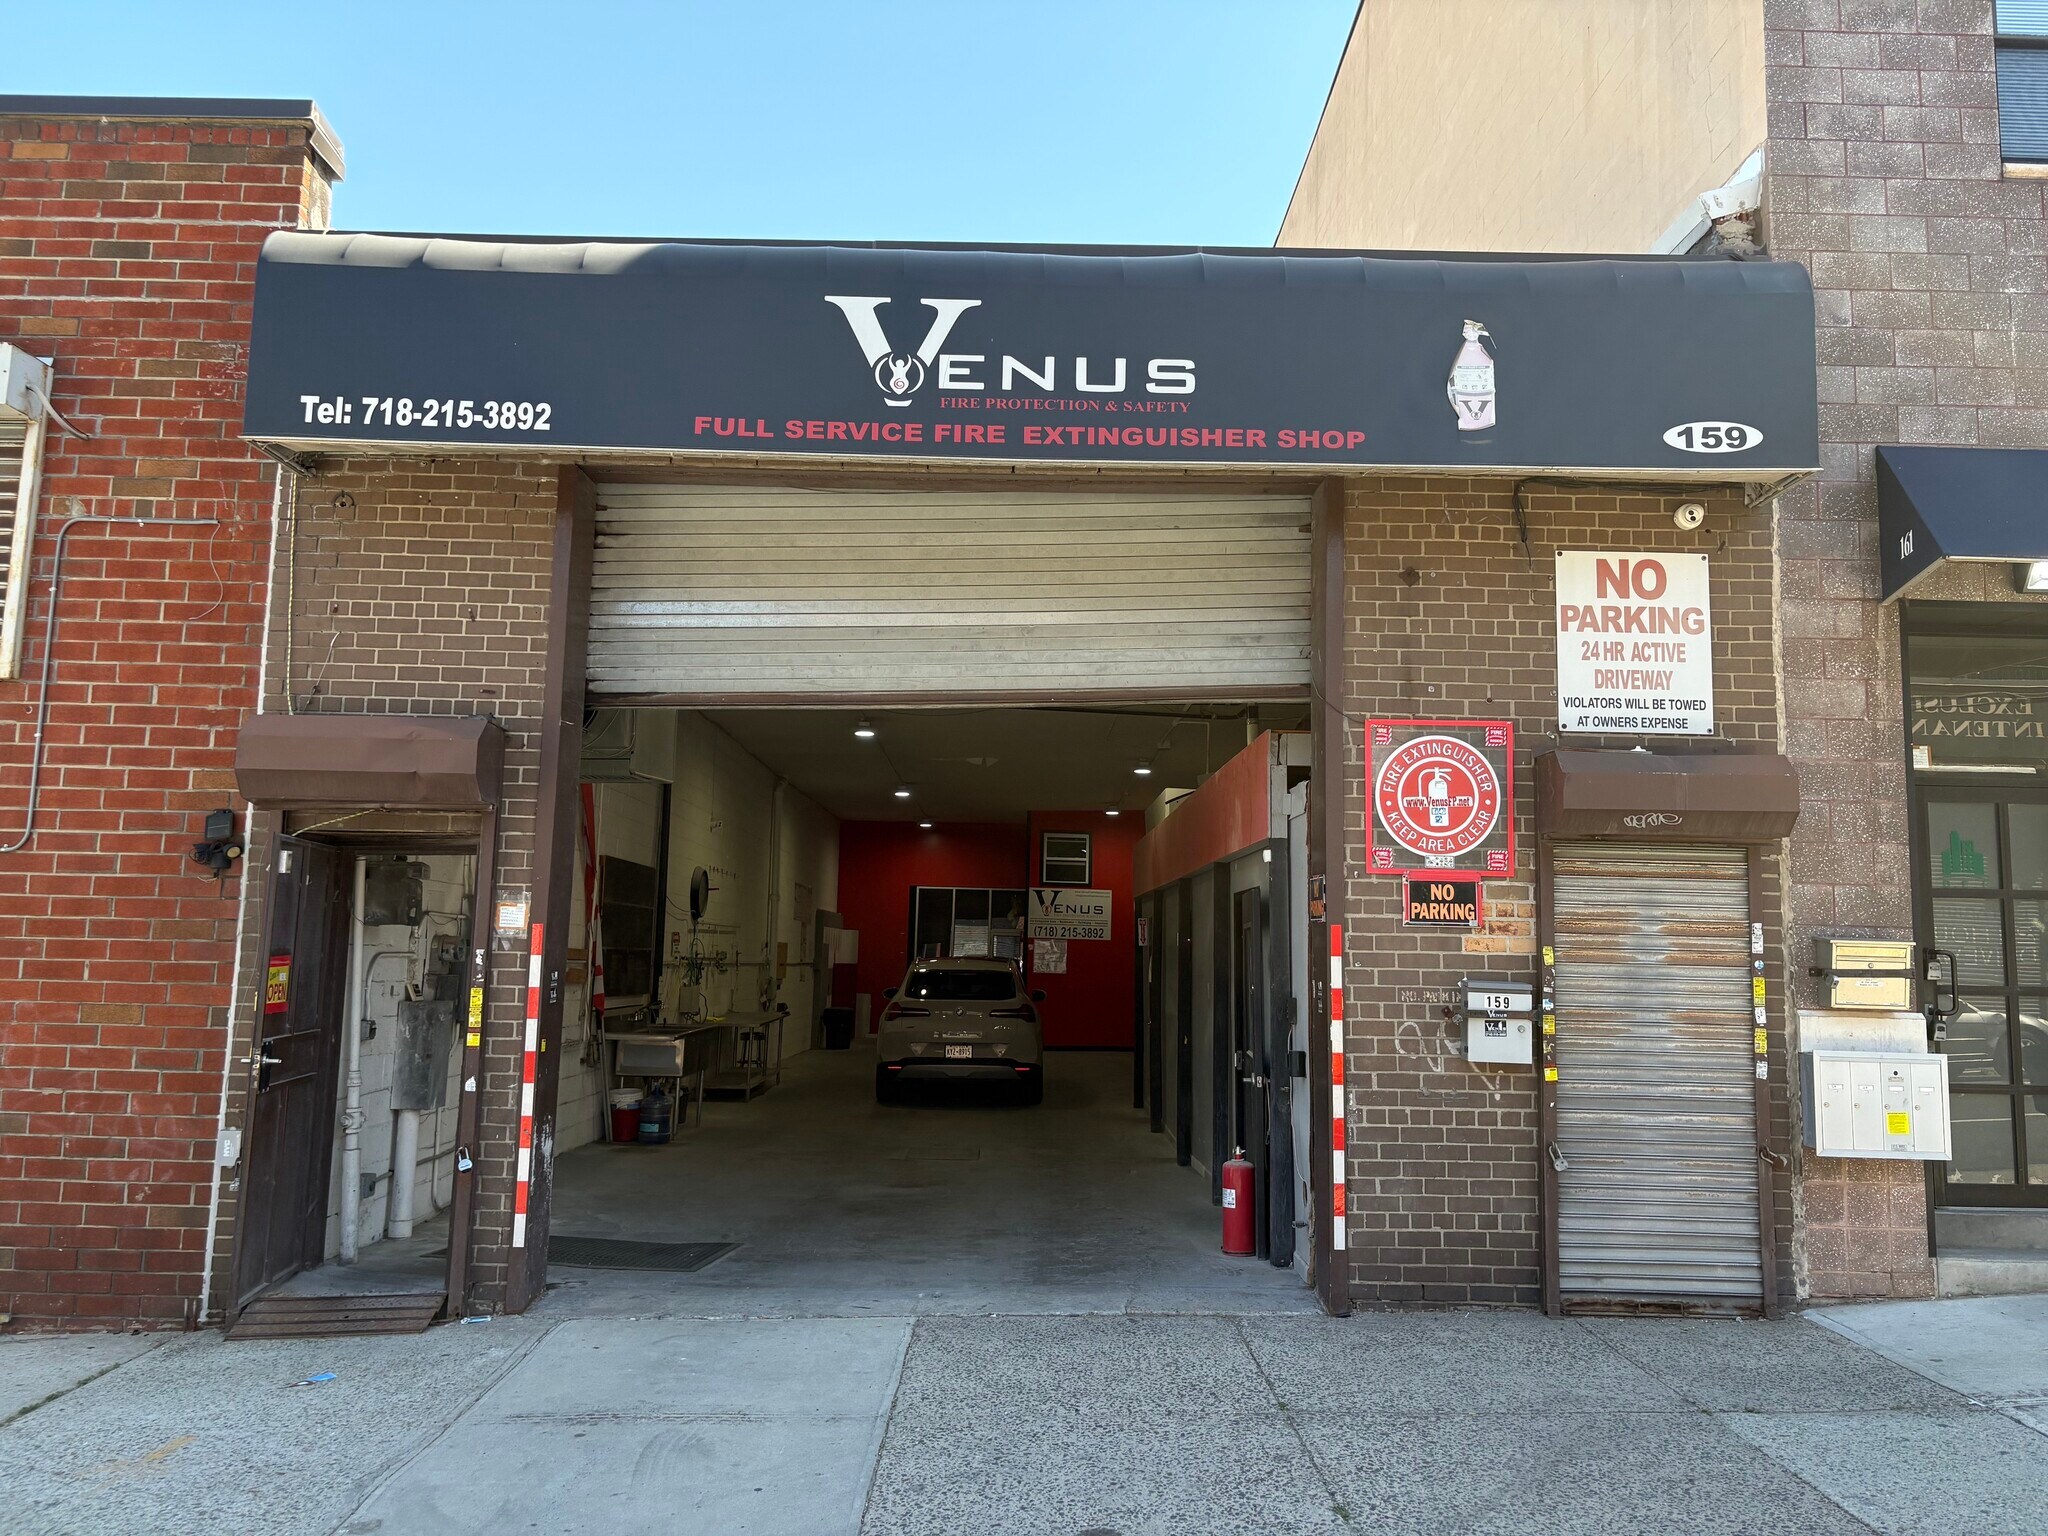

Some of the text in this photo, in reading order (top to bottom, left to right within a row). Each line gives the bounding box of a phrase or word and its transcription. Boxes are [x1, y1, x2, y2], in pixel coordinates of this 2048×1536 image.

[824, 295, 1196, 407] VENUS
[300, 395, 552, 431] Tel: 718-215-3892
[940, 397, 1192, 413] FIRE PROTECTION & SAFETY
[694, 416, 1366, 449] FULL SERVICE FIRE EXTINGUISHER SHOP
[1677, 426, 1747, 449] 159
[1899, 529, 1914, 560] 161
[1596, 558, 1667, 600] NO
[1560, 605, 1705, 635] PARKING
[1581, 641, 1686, 663] 24 HR ACTIVE
[1594, 669, 1673, 690] DRIVEWAY
[1563, 697, 1706, 711] VIOLATORS WILL BE TOWED
[1577, 716, 1689, 729] AT OWNERS EXPENSE
[1383, 743, 1492, 793] FIRE EXTINGUISHER
[1387, 810, 1492, 852] KEEP AREA CLEAR
[1032, 890, 1103, 916] VENUS
[1430, 884, 1455, 901] NO
[1411, 903, 1475, 920] PARKING
[1034, 926, 1104, 938] (718) 215-3892
[1486, 996, 1510, 1009] 159
[223, 1139, 231, 1157] NYC
